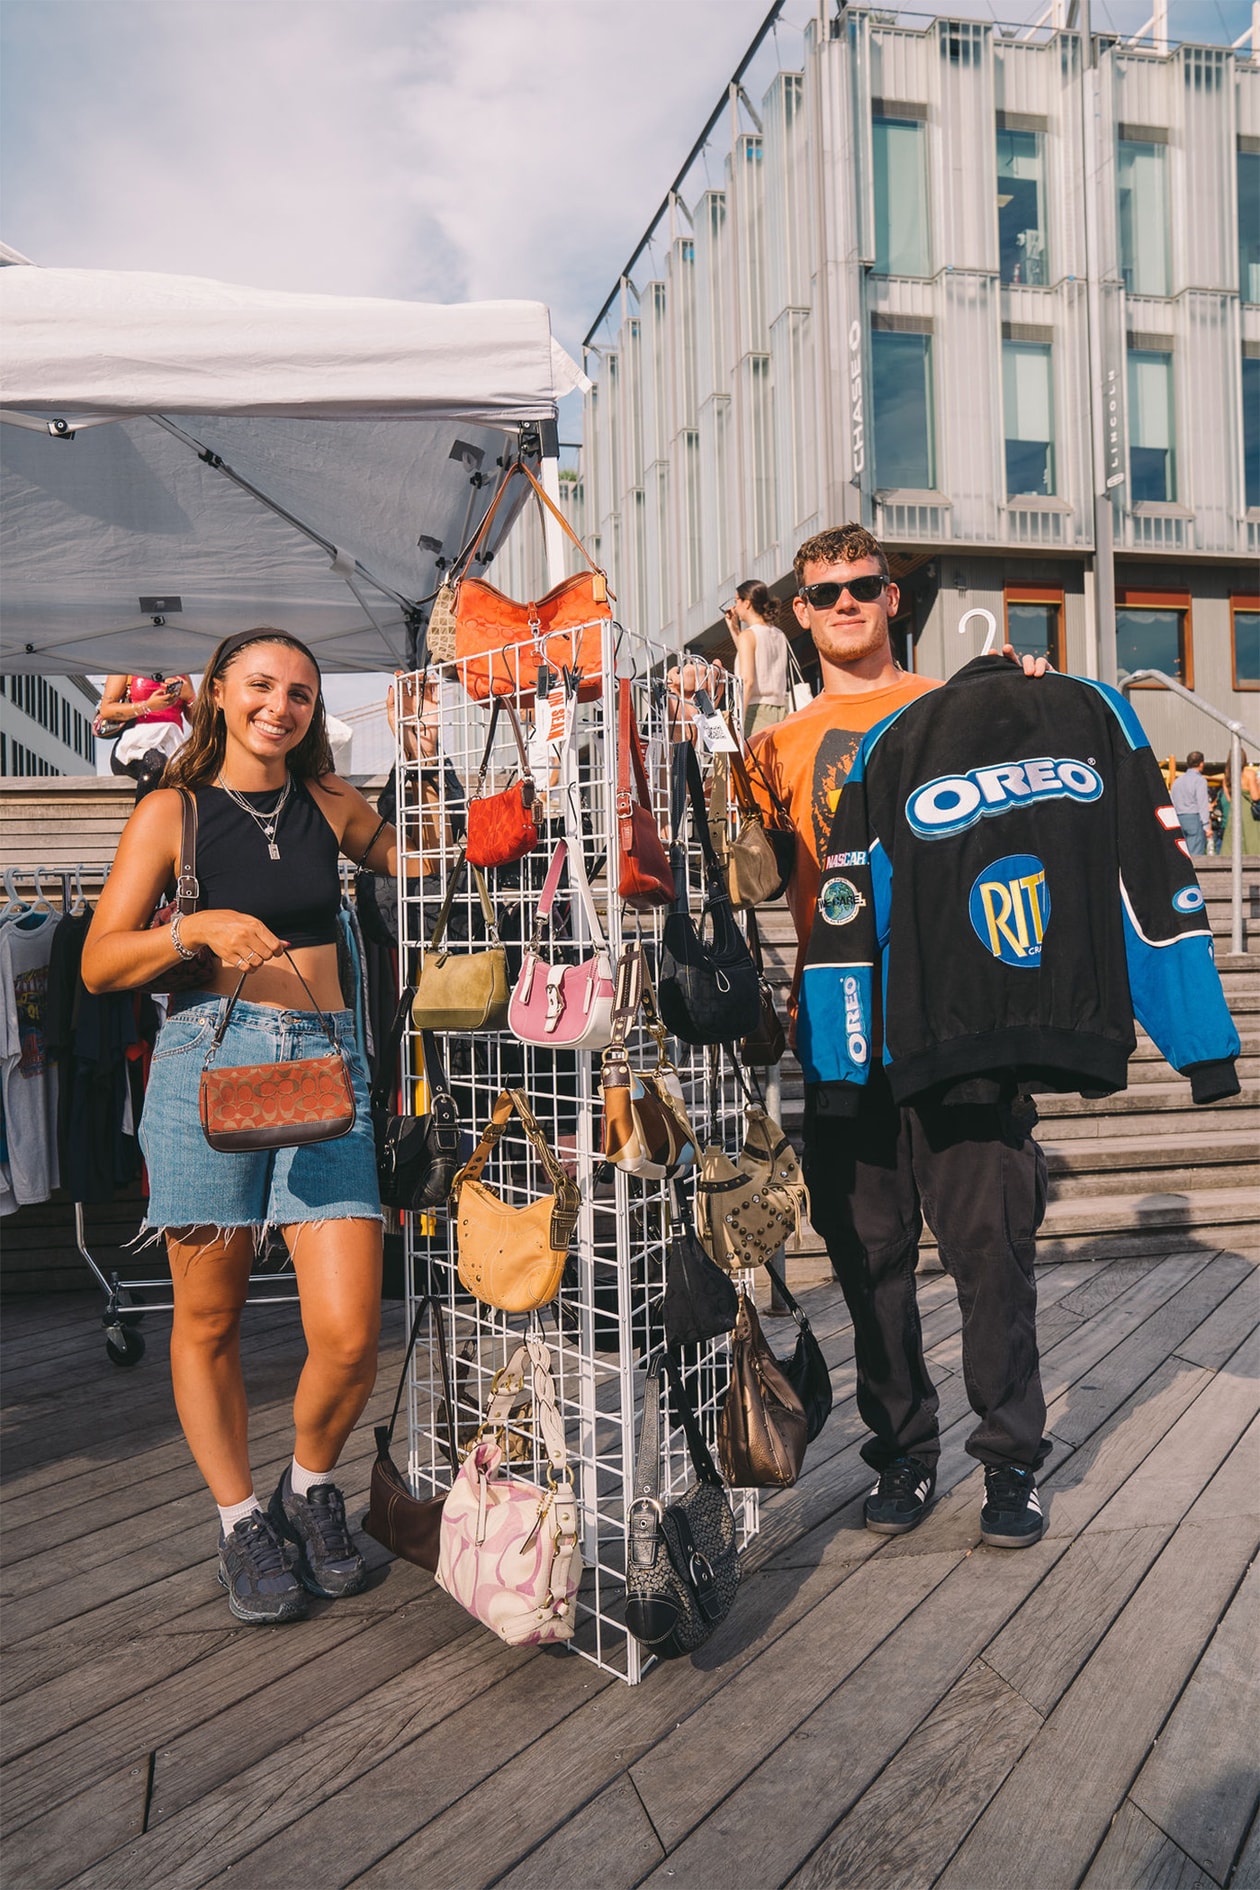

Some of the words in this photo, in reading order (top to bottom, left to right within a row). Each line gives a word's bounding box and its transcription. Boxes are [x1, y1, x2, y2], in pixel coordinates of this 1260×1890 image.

[850, 354, 865, 474] CHASE
[1107, 369, 1119, 468] LINCOLN
[547, 691, 565, 708] ON
[913, 760, 1099, 825] OREO
[825, 850, 867, 870] NASCAR
[979, 868, 1045, 958] RIT
[843, 976, 868, 1064] OREO
